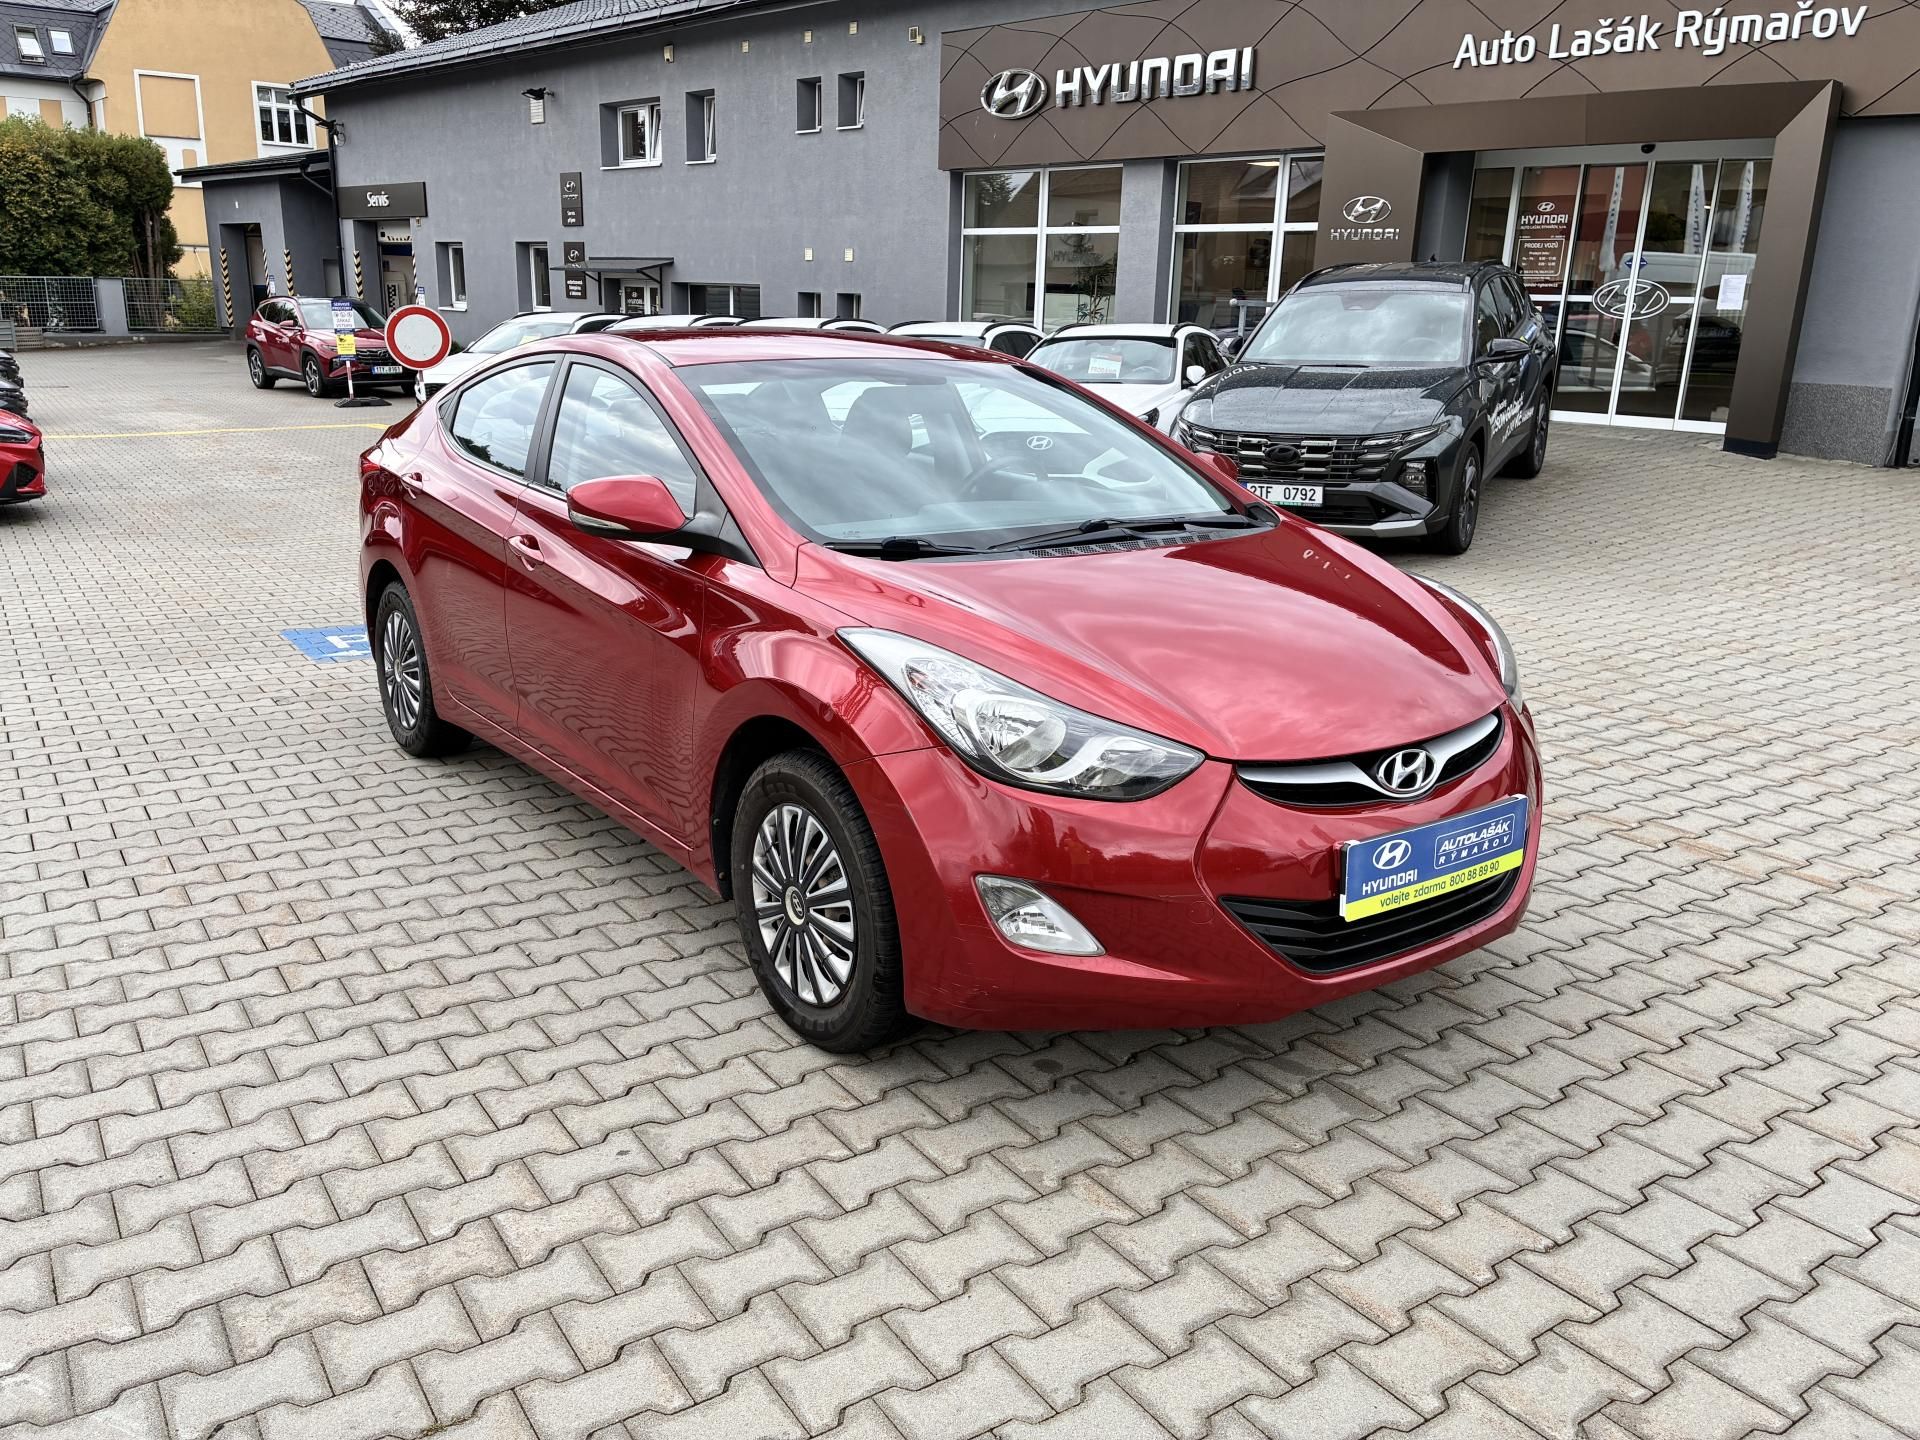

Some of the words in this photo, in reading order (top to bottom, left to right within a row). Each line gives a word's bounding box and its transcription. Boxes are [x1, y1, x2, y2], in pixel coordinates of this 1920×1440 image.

[1453, 30, 1536, 69] Auto
[1549, 15, 1663, 60] Lašák
[1674, 0, 1868, 56] Rýmařov
[1056, 47, 1254, 108] HYUNDAI
[366, 191, 389, 207] Servis
[1521, 215, 1568, 224] HYUNDAI
[1330, 228, 1400, 240] HYUNDAI
[1283, 487, 1316, 501] 0792
[1439, 820, 1511, 852] AUTOLAŠÁK
[1362, 868, 1418, 895] HYUNDAI
[1380, 891, 1410, 907] volejte
[1413, 880, 1447, 898] zdarma
[1449, 873, 1466, 887] 800
[1466, 869, 1479, 881] 88
[1478, 865, 1489, 877] 89
[1489, 860, 1500, 873] 90
